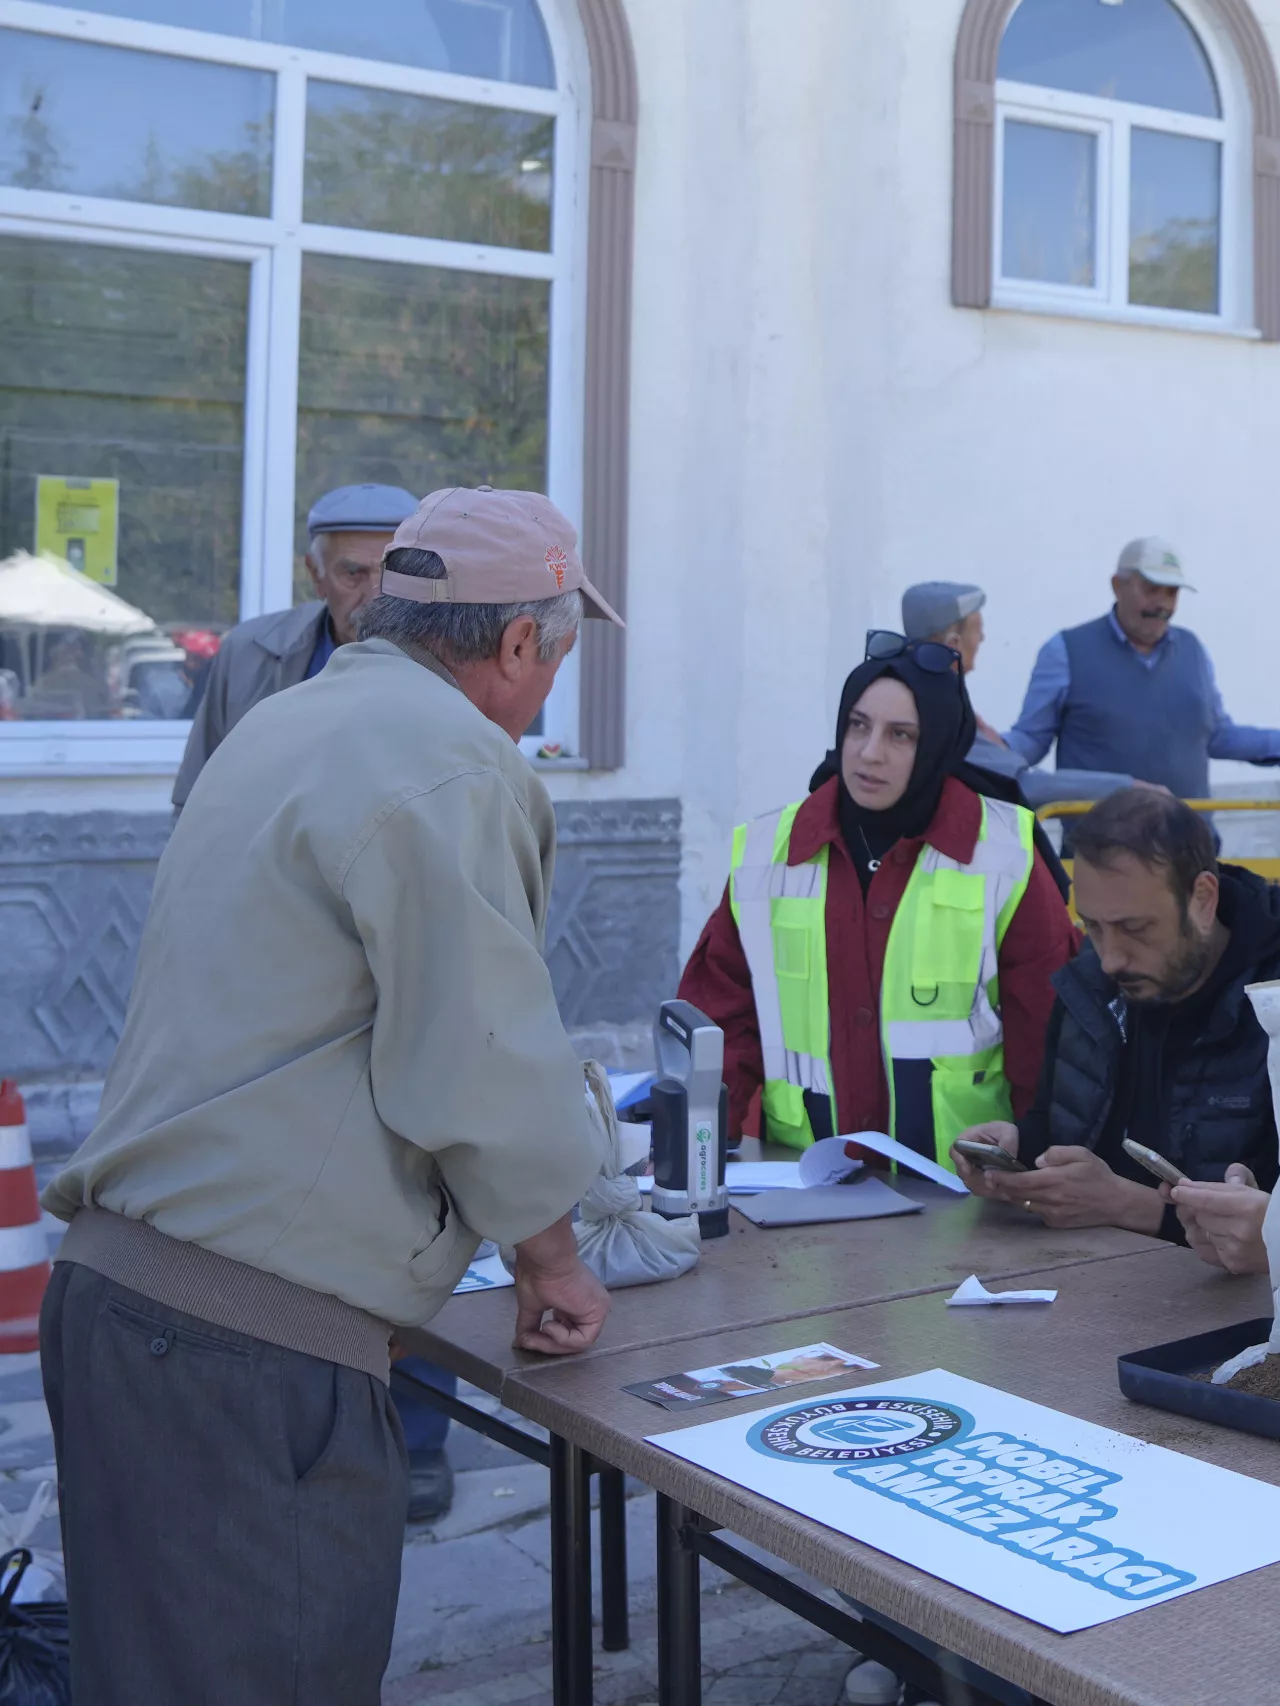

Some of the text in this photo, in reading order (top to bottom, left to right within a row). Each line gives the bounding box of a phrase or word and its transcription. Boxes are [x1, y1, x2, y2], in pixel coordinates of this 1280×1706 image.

[765, 1403, 933, 1459] BÜYÜKŞEHİR BELEDİYESİ
[876, 1401, 959, 1431] ESKİŞEHİR
[912, 1448, 1104, 1525] TOPRAK
[954, 1435, 1111, 1495] MOBİL
[847, 1463, 1182, 1596] ANALİZ ARACI
